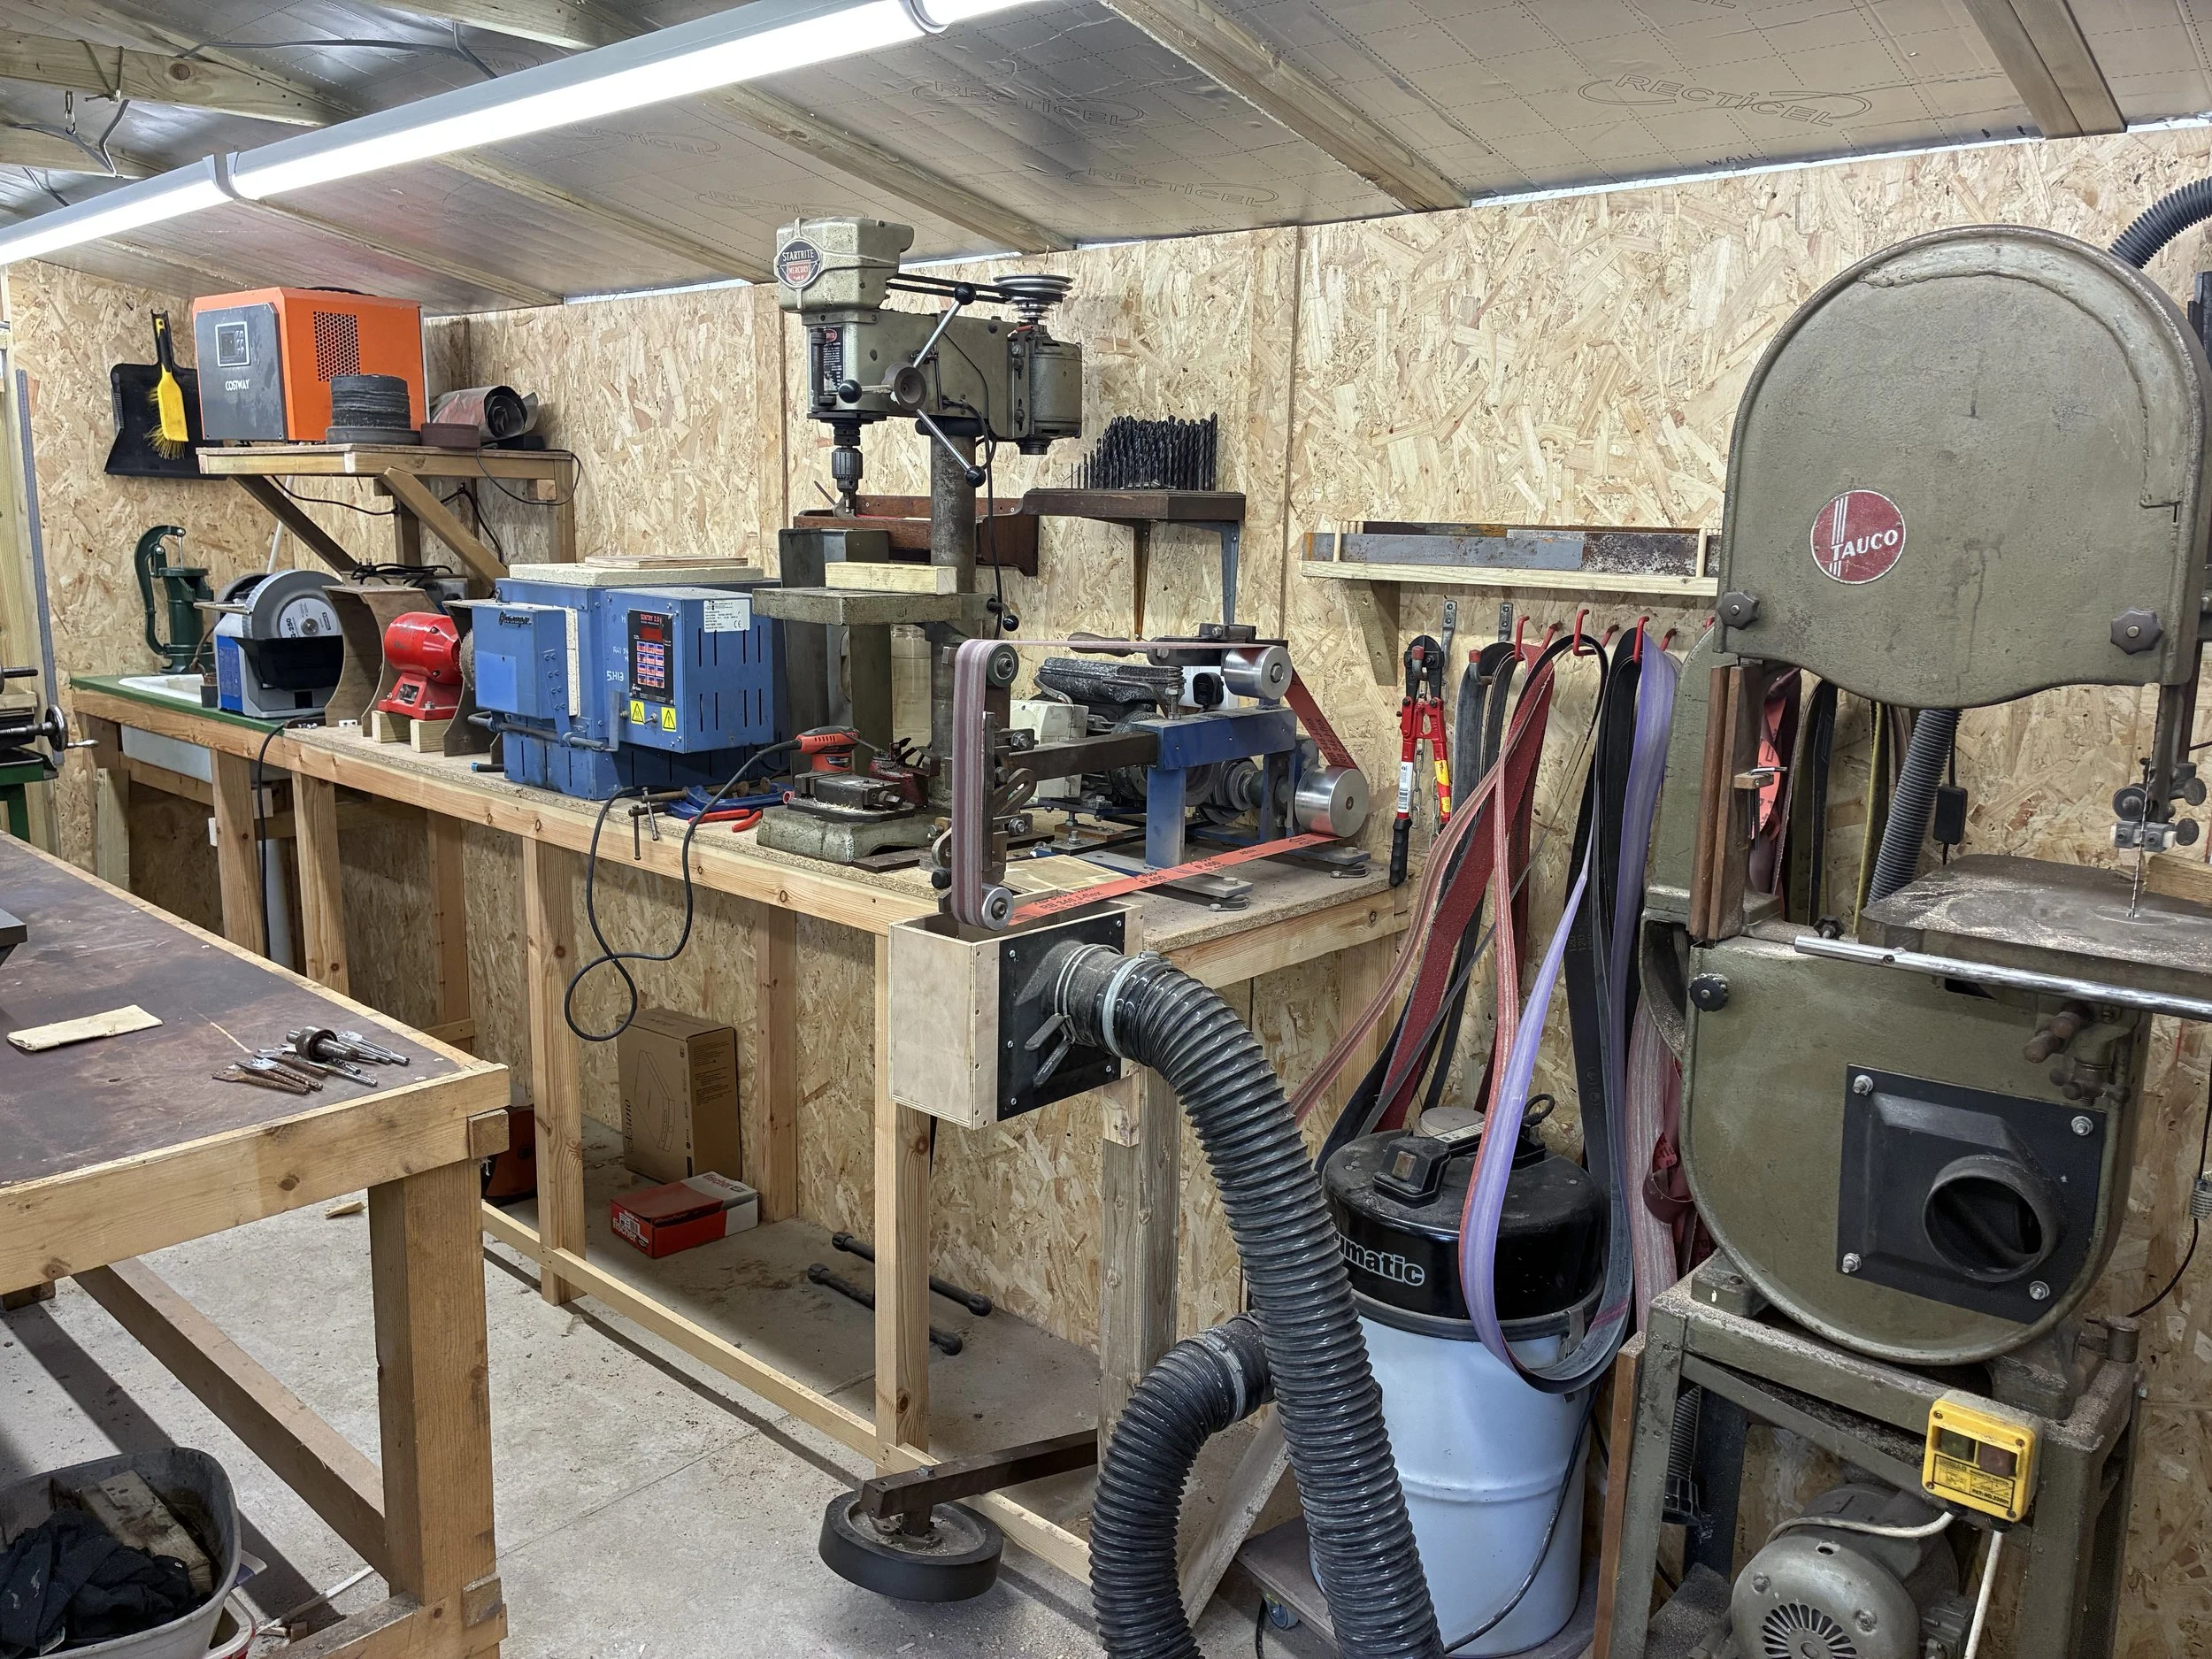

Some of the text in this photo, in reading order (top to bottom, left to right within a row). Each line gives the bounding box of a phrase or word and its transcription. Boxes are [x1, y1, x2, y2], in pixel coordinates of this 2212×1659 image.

[1615, 67, 1833, 127] RECTICEL
[1705, 152, 1767, 167] WALL
[1087, 165, 1264, 209] RECTICEL
[781, 249, 815, 262] STARTRITE
[225, 378, 251, 391] COSTWAY
[1830, 529, 1899, 561] TAUCO
[1330, 1221, 1425, 1287] umatic
